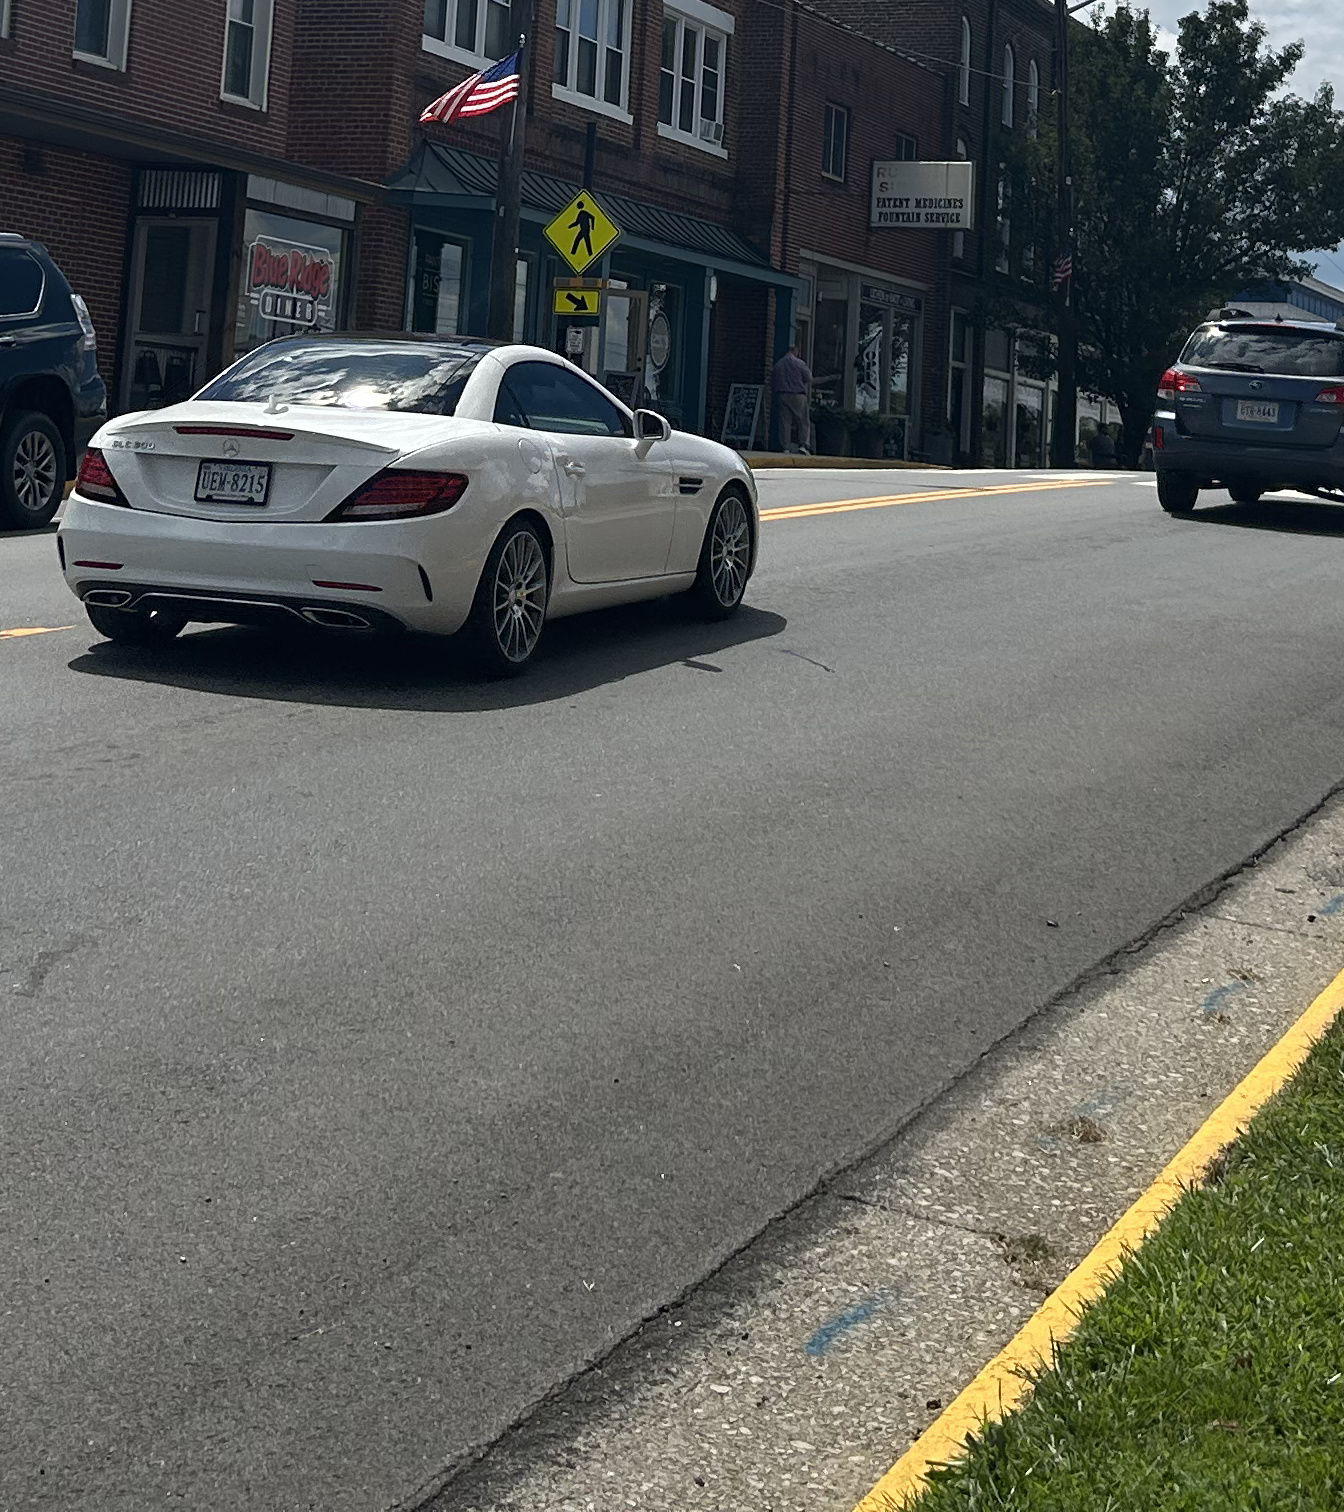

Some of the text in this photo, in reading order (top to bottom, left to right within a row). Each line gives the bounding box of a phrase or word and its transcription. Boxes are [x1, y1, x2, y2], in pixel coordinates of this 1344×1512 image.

[915, 198, 964, 209] MEDICINES
[878, 211, 961, 223] FOUNTAIN SERVICE
[252, 243, 289, 289] Blue
[265, 296, 313, 320] DINER
